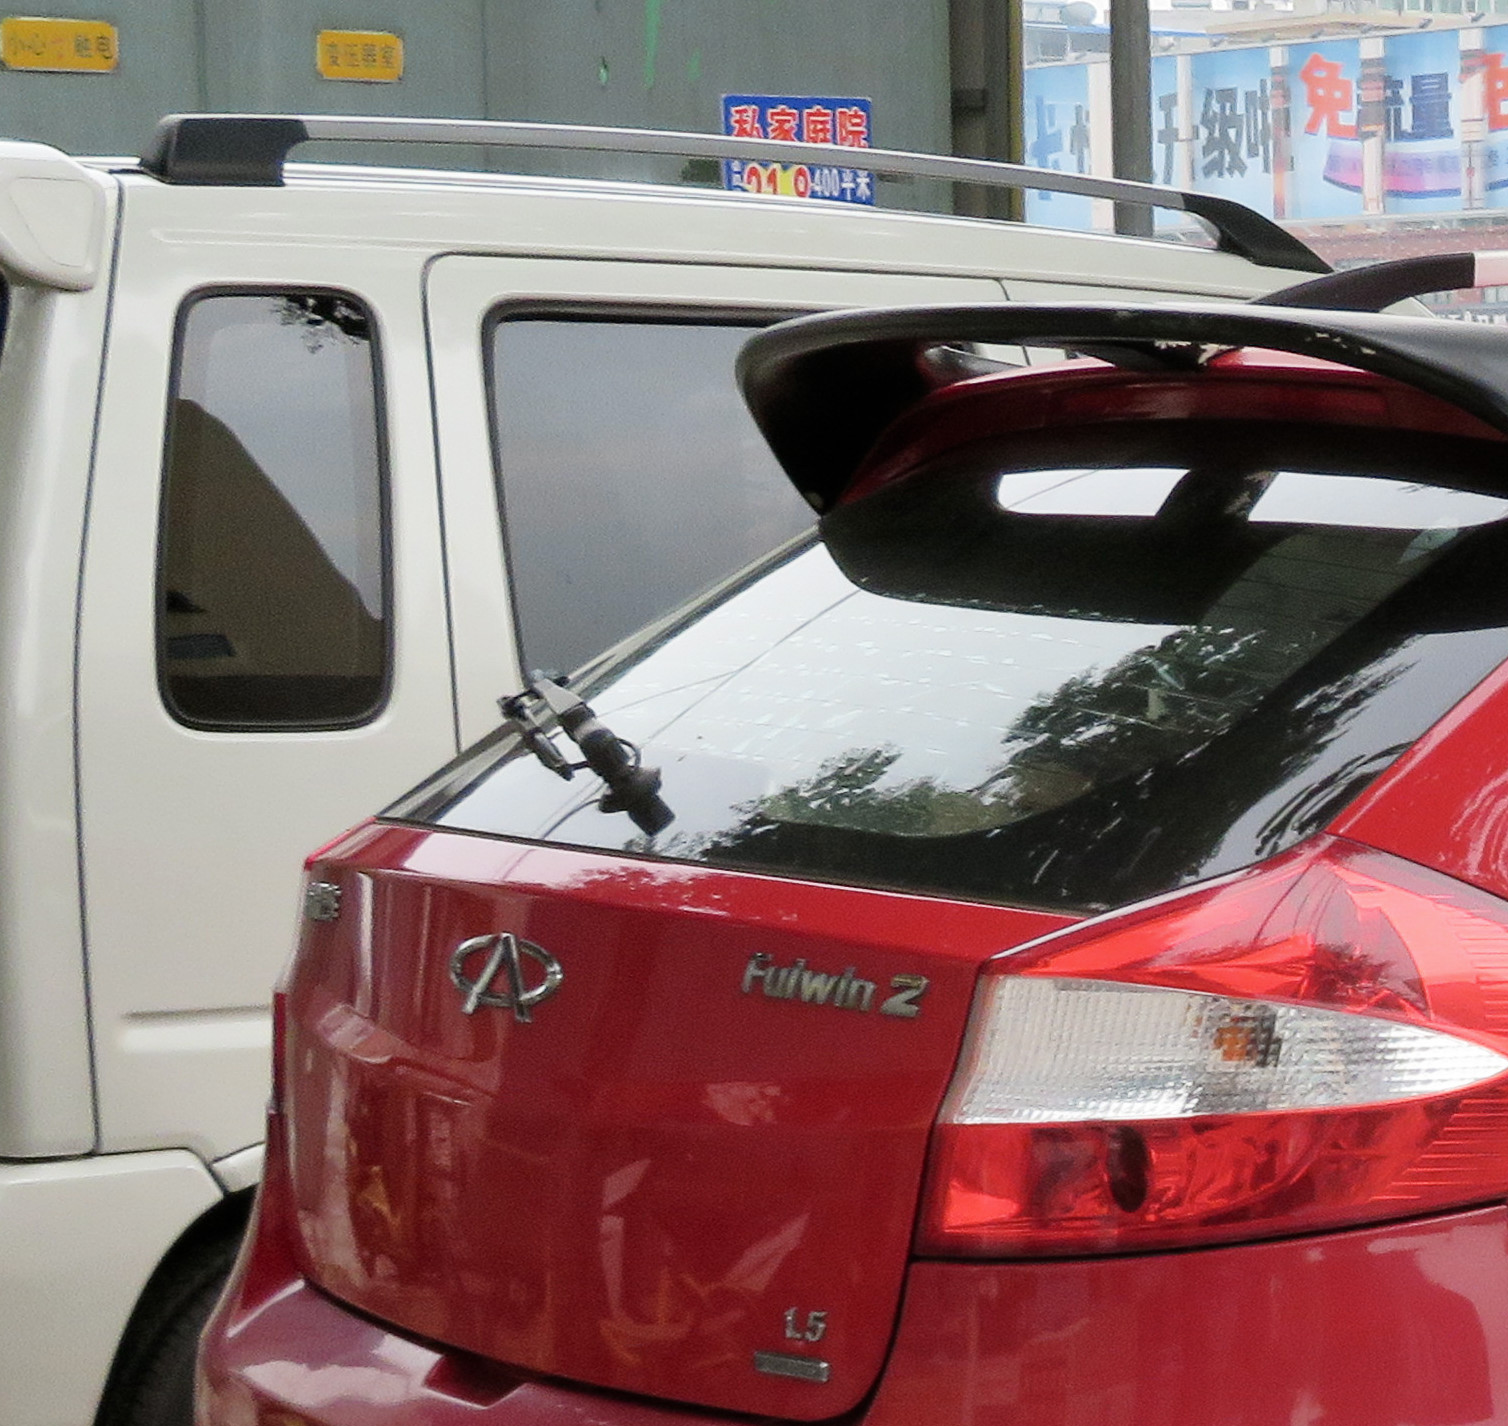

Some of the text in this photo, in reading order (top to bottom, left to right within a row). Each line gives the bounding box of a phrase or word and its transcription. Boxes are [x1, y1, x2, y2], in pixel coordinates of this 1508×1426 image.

[730, 104, 870, 149] 私家庭院
[741, 951, 930, 1018] Fulwin 2
